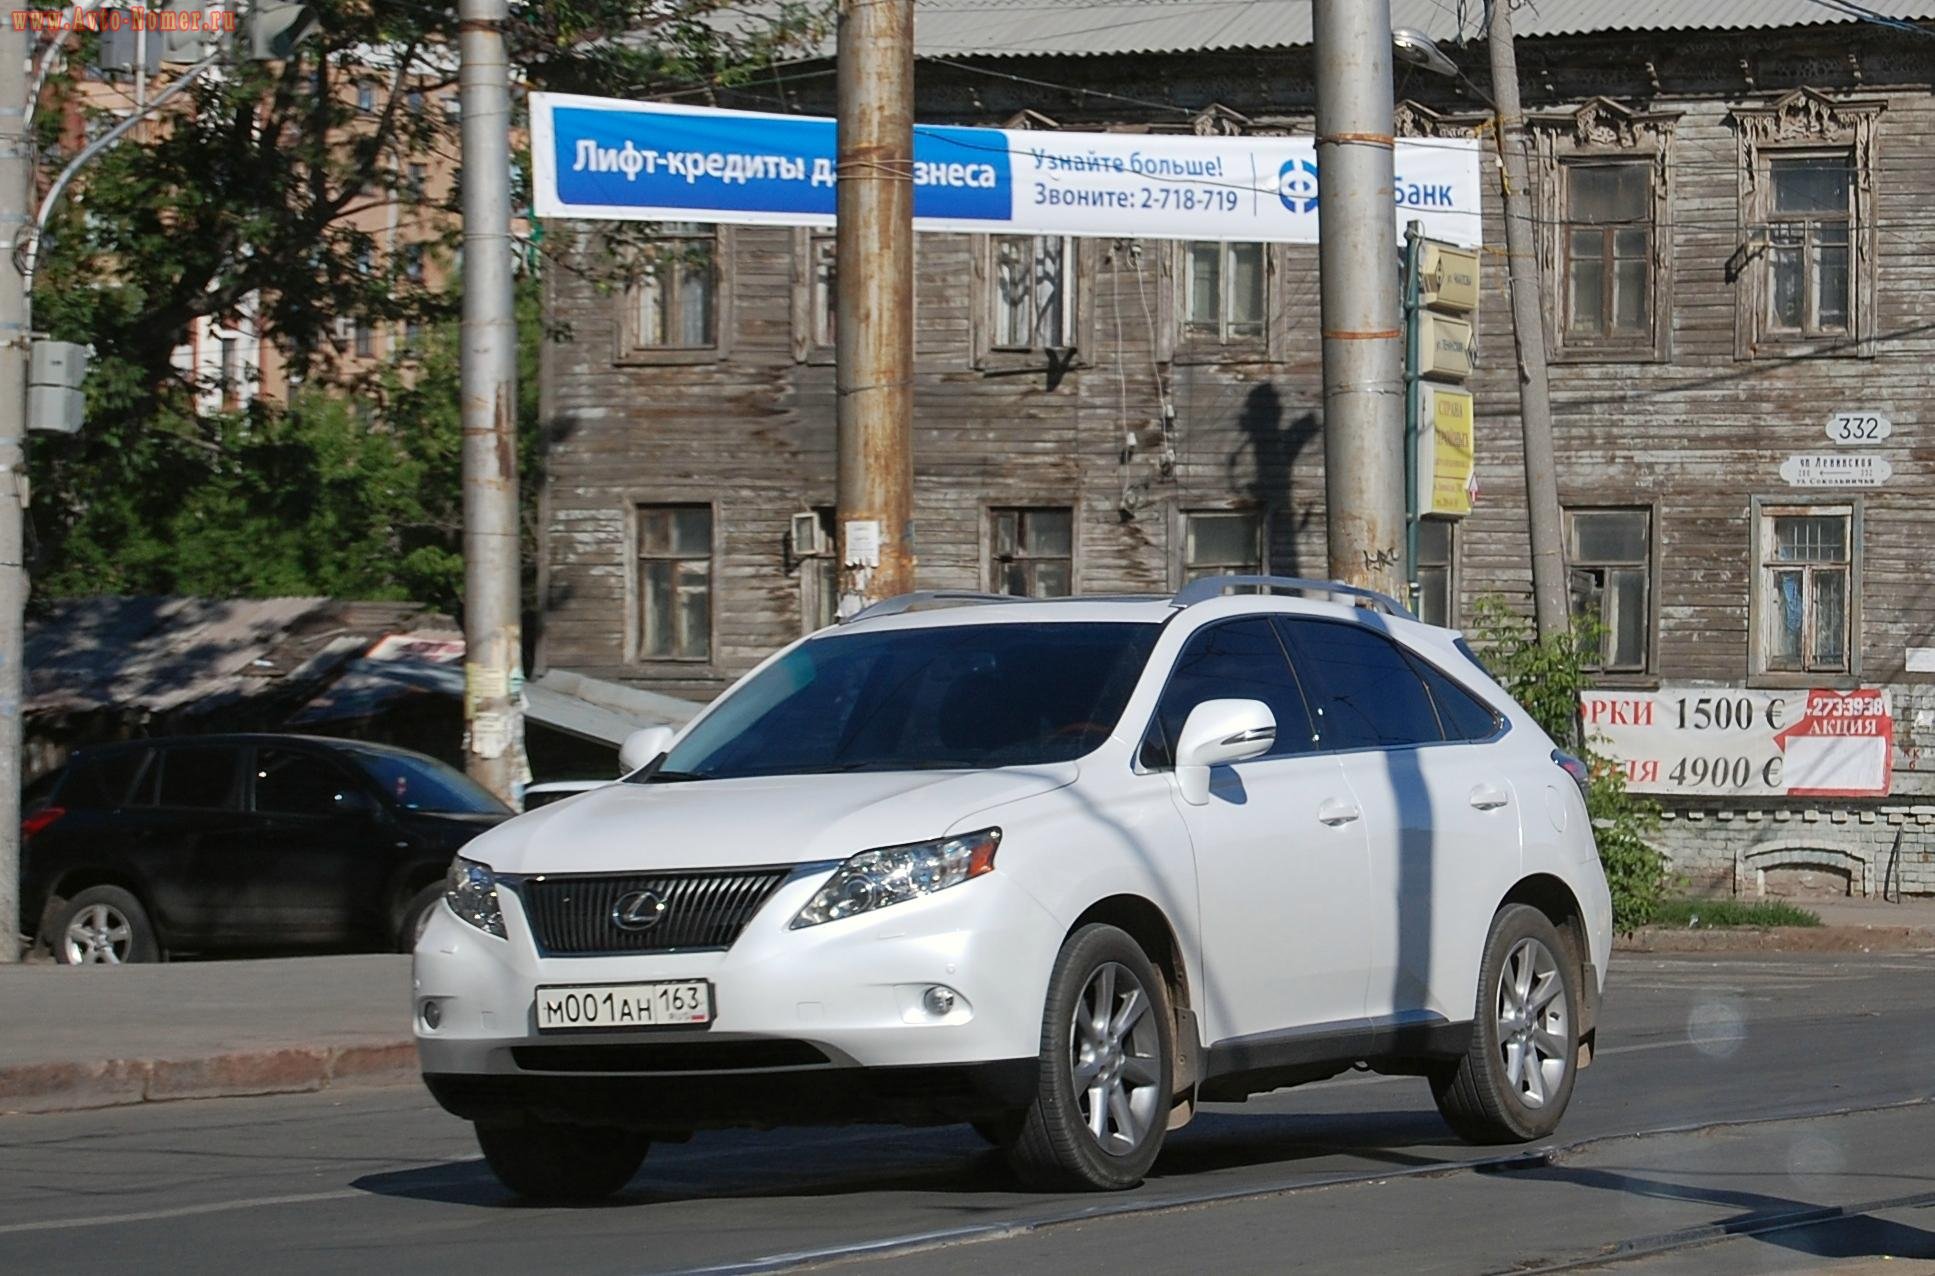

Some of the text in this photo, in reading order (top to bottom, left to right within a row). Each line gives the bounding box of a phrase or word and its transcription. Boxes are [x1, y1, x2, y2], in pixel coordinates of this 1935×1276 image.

[573, 138, 805, 182] Лифт-кредиты
[914, 161, 996, 188] знеса
[1031, 147, 1223, 178] Узнайте больше!
[1034, 182, 1238, 212] Звоните: 2-718-719
[1839, 417, 1879, 440] 332
[1677, 696, 1754, 731] 1500
[1766, 696, 1786, 731] €
[1809, 718, 1878, 737] АКЦИЯ
[1669, 756, 1751, 788] 4900
[1762, 755, 1784, 788] €
[659, 987, 699, 1012] 163
